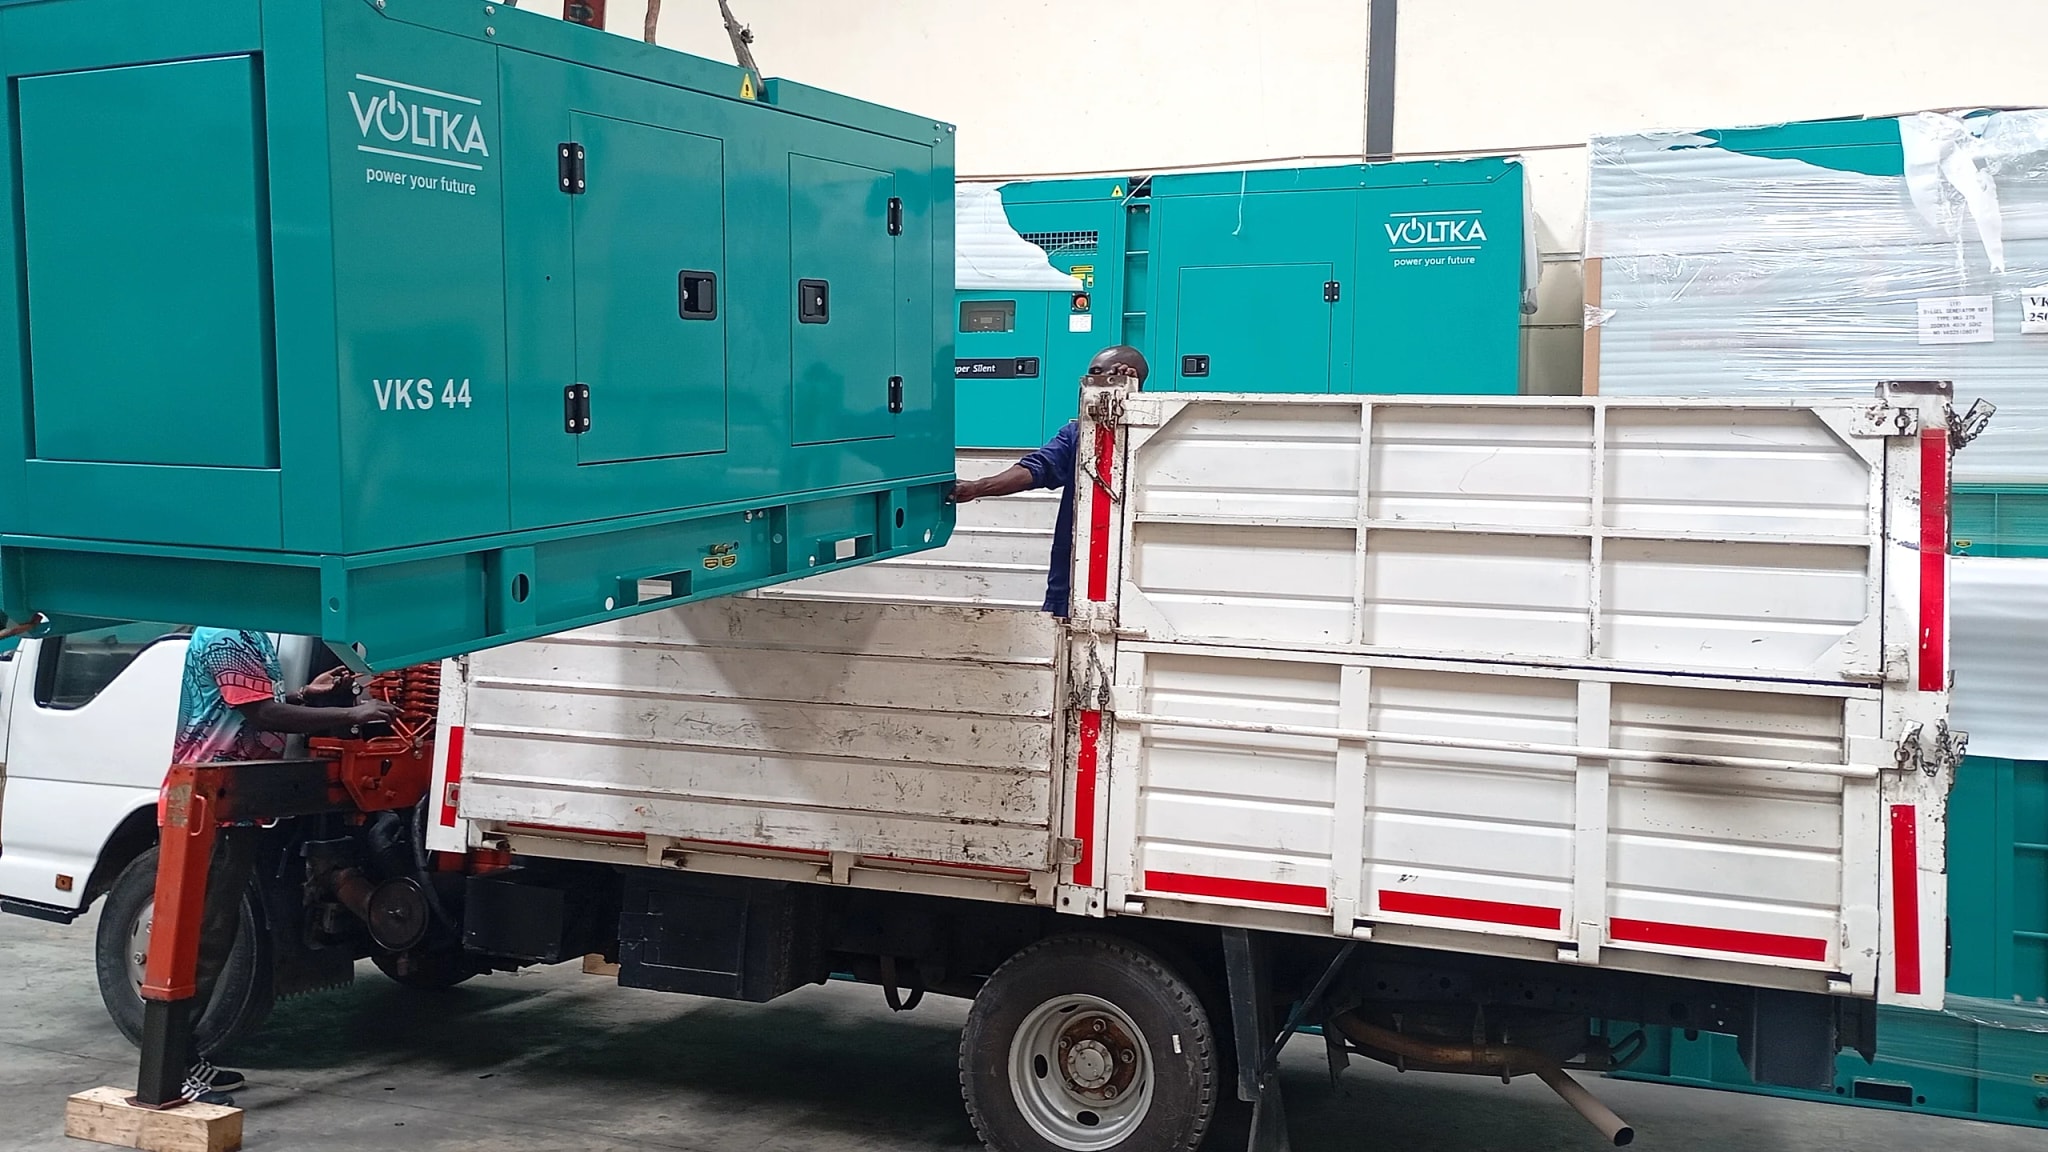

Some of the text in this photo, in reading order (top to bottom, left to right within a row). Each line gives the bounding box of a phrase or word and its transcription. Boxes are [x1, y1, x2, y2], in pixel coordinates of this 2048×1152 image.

[348, 89, 489, 157] VOLTKA
[366, 167, 476, 195] power your future
[1384, 217, 1488, 246] VOLTKA
[1394, 256, 1475, 268] power your future
[972, 363, 996, 372] Silent
[373, 378, 473, 411] VKS 44
